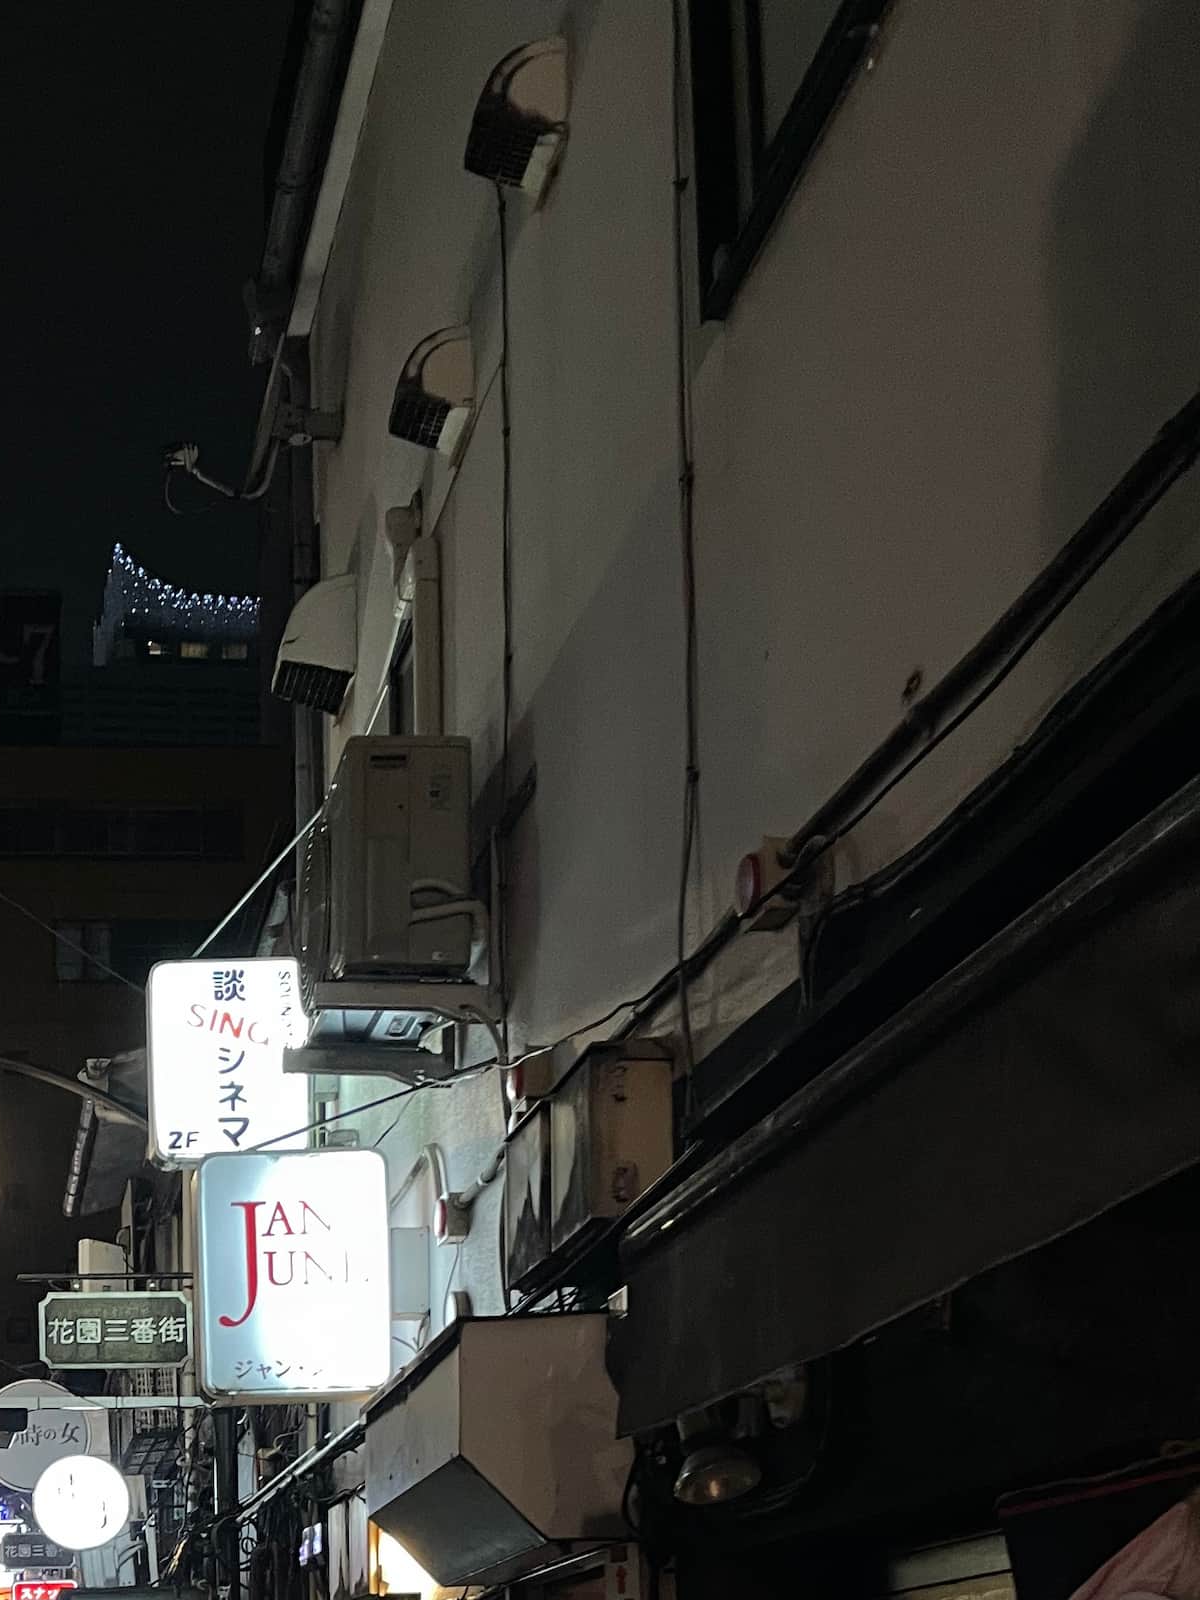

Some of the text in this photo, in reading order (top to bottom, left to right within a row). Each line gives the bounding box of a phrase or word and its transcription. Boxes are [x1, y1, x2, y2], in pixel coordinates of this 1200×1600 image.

[168, 1131, 200, 1150] 2F
[48, 1316, 186, 1345] 花園三番街
